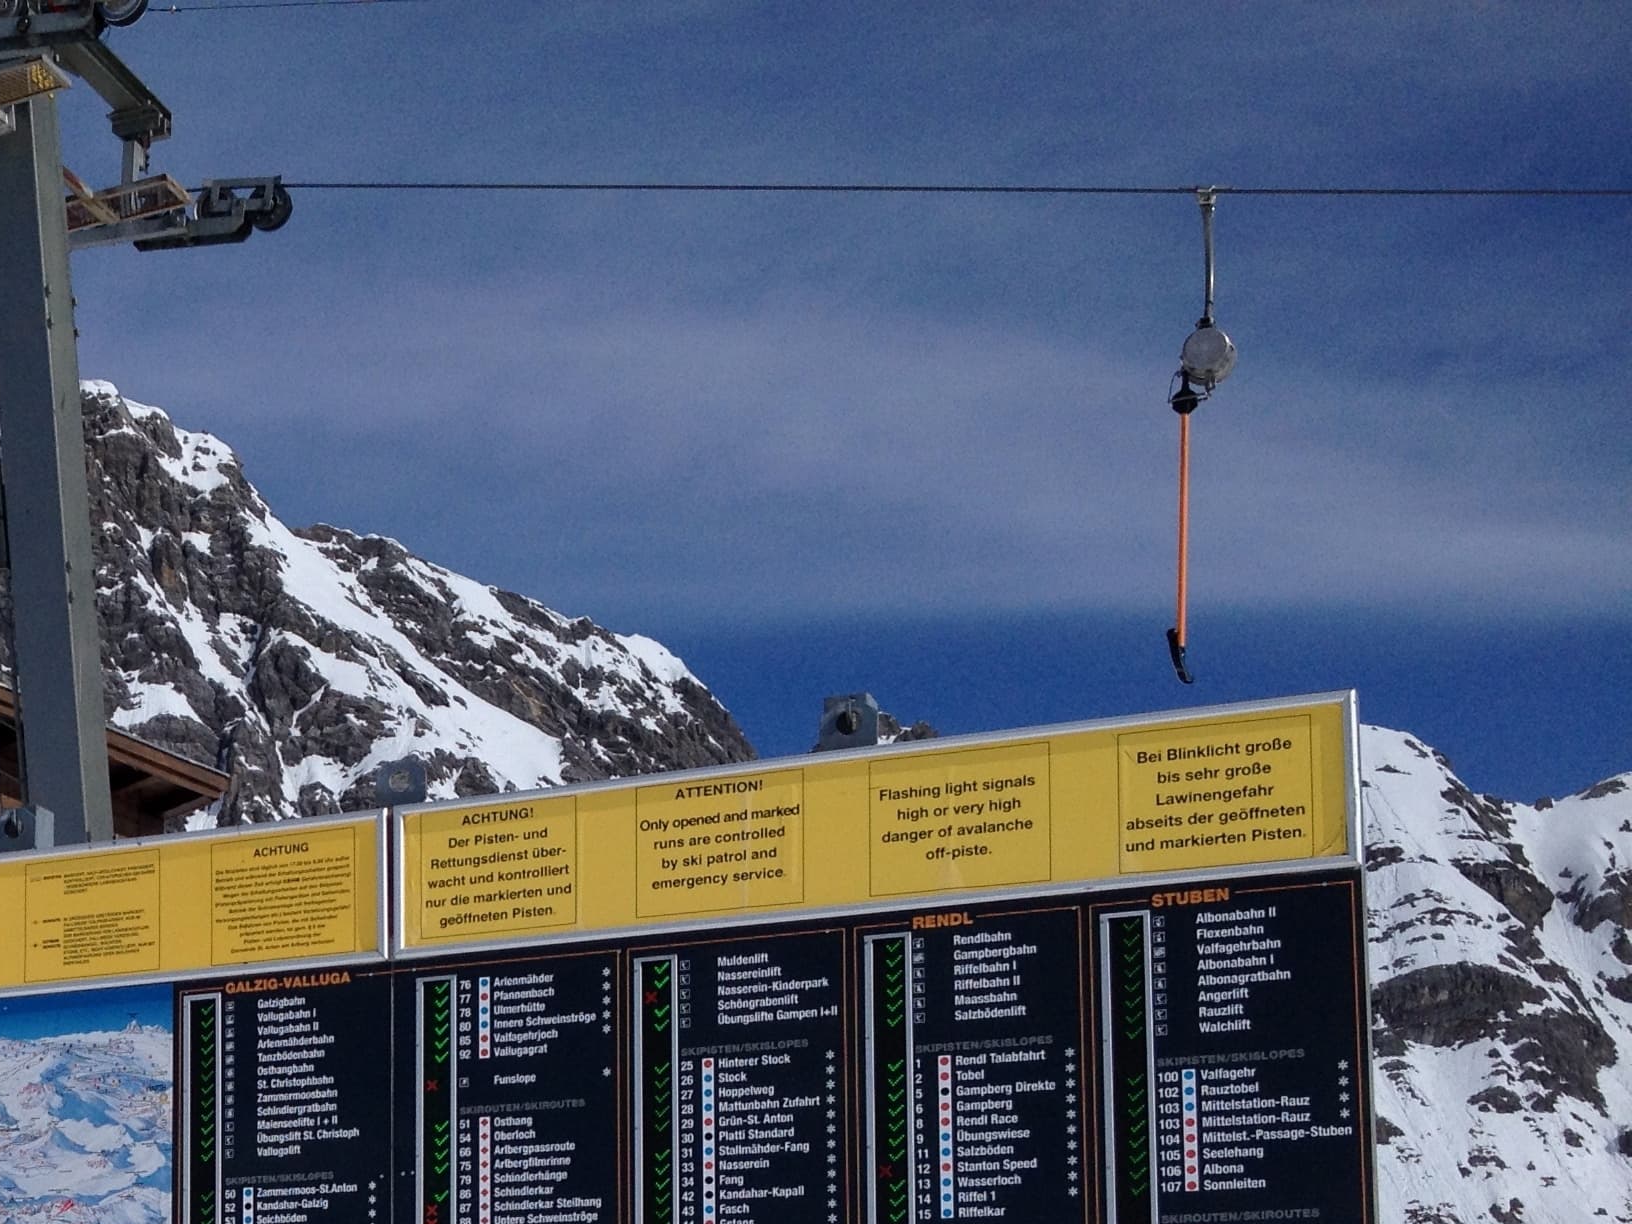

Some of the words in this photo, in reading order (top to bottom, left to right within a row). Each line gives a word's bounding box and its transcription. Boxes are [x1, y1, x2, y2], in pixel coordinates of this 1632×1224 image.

[1136, 748, 1163, 765] Bei
[1166, 742, 1241, 762] Blinklicht
[1245, 737, 1292, 758] große
[1156, 768, 1181, 785] bis
[1184, 765, 1220, 781] sehr
[1224, 761, 1272, 781] große
[675, 780, 764, 800] ATTENTION!
[879, 783, 941, 803] Flashing
[945, 778, 978, 797] light
[982, 774, 1036, 794] signals
[1155, 782, 1274, 807] Lawinengefahr
[462, 807, 535, 827] ACHTUNG!
[639, 815, 670, 834] Only
[672, 811, 721, 832] opened
[724, 808, 748, 825] and
[751, 803, 800, 822] marked
[897, 806, 930, 824] high
[933, 804, 949, 817] or
[952, 802, 984, 819] very
[988, 797, 1021, 816] high
[1125, 812, 1183, 832] abseits
[1187, 809, 1215, 826] der
[1219, 803, 1306, 826] geöffneten
[448, 834, 470, 849] Der
[474, 831, 519, 847] Pisten-
[523, 827, 548, 842] und
[653, 836, 685, 850] runs
[688, 833, 711, 847] are
[714, 825, 786, 844] controlled
[881, 827, 934, 847] danger
[937, 823, 953, 838] of
[956, 817, 1034, 837] avalanche
[1125, 836, 1155, 853] und
[1159, 829, 1247, 850] markierten
[1251, 825, 1307, 843] Pisten.
[253, 842, 309, 858] ACHTUNG
[430, 849, 530, 873] Rettungsdienst
[532, 843, 567, 861] über-
[661, 855, 679, 872] by
[682, 851, 703, 867] ski
[706, 848, 747, 868] patrol
[752, 845, 777, 862] and
[925, 844, 993, 863] off-piste.
[427, 873, 466, 890] wacht
[469, 870, 494, 886] und
[497, 864, 570, 882] kontrolliert
[651, 873, 728, 893] emergency
[425, 896, 447, 910] nur
[450, 891, 470, 907] die
[473, 886, 544, 905] markierten
[546, 883, 572, 898] und
[1151, 888, 1230, 908] STUBEN
[439, 907, 509, 929] geöffneten
[512, 903, 556, 920] Pisten.
[912, 912, 974, 930] RENDL
[1195, 909, 1266, 925] Albonabahn
[953, 931, 1012, 946] Rendlbahn
[1197, 938, 1281, 956] Valfagehrbahn
[718, 953, 769, 967] Muldenlift
[1197, 955, 1267, 971] Albonabahn
[225, 971, 351, 995] GALZIG-VALLUGA
[1198, 969, 1291, 987] Albonagratbahn
[1198, 988, 1250, 1003] Angerlift
[1199, 1004, 1244, 1018] Rauzlift
[1199, 1019, 1252, 1034] Walchlift
[718, 1055, 759, 1068] Hinterer
[762, 1053, 791, 1066] Stock
[956, 1070, 985, 1081] Tobel
[1158, 1072, 1179, 1083] 100
[1200, 1067, 1256, 1082] Valfagehr
[1158, 1087, 1180, 1098] 102
[1201, 1082, 1259, 1097] Rauztobel
[1158, 1103, 1180, 1114] 103
[1201, 1095, 1310, 1113] Mittelstation-Rauz
[1159, 1135, 1180, 1146] 104
[1160, 1150, 1181, 1161] 105
[1203, 1146, 1264, 1160] Seelehang
[1160, 1166, 1182, 1177] 106
[1203, 1163, 1244, 1176] Albona
[1160, 1182, 1182, 1193] 107
[1204, 1178, 1266, 1191] Sonnleiten
